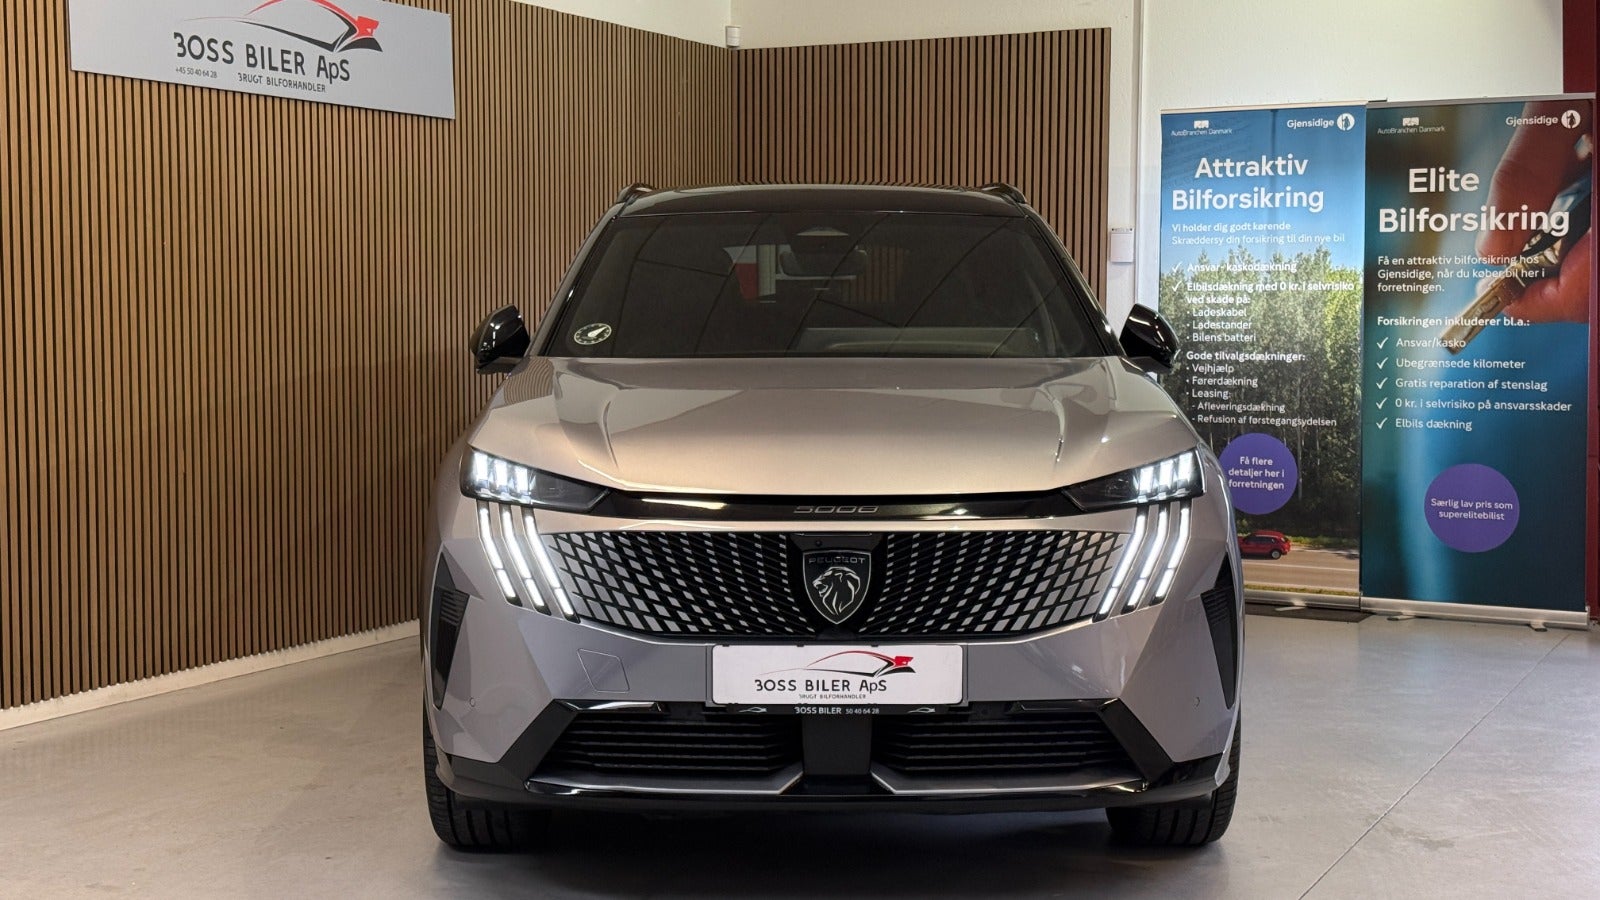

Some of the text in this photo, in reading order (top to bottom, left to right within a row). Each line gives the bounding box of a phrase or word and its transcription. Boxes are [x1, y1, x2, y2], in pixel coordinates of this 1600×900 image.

[245, 43, 306, 76] BILER
[316, 54, 350, 85] ApS
[266, 76, 326, 93] BILFORHANDLER
[1287, 118, 1335, 129] Gjensidige
[1505, 115, 1559, 127] Gjensidige
[1208, 128, 1233, 136] Danmark
[1418, 126, 1446, 134] Danmark
[1194, 153, 1309, 179] Attraktiv
[1408, 166, 1480, 193] Elite
[1172, 186, 1324, 213] Bilforsikring
[1379, 204, 1570, 237] Bilforsikring
[1172, 222, 1291, 234] Vi holder dig godt kørende
[1172, 233, 1345, 247] Skræddersy din forsikring til din nye bil
[1378, 255, 1540, 267] Få en attraktiv bilforsikring hos
[1377, 269, 1435, 280] Gjensidige,
[1437, 268, 1454, 279] når
[1456, 268, 1470, 278] du
[1521, 268, 1539, 278] her
[1541, 268, 1545, 278] i
[1256, 282, 1278, 291] med
[1279, 282, 1287, 291] 0
[1288, 282, 1301, 291] kr.
[1307, 283, 1355, 292] selvrisiko
[1377, 282, 1445, 294] forretningen.
[1187, 295, 1206, 305] ved
[1206, 295, 1234, 305] skade
[1192, 308, 1247, 318] Ladeskabel
[1192, 321, 1253, 330] Ladestander
[1377, 316, 1443, 328] Forsikringen
[1445, 317, 1501, 327] inkluderer
[1192, 333, 1257, 342] Bilens batteri
[1396, 337, 1467, 349] Ansvar/kasko
[1186, 351, 1306, 364] Gode tilvalgsdækninger:
[1192, 364, 1235, 375] Vejhjælp
[1396, 358, 1526, 370] Ubegrænsede kilometer
[1192, 377, 1259, 388] Førerdækning
[1395, 378, 1549, 393] Gratis reparation af stenslag
[1197, 402, 1286, 414] Afleveringsdækning
[1395, 399, 1403, 408] 0
[1405, 399, 1418, 409] kr.
[1425, 399, 1476, 410] selvrisiko
[1477, 400, 1492, 413] på
[1494, 401, 1573, 412] ansvarsskader
[1197, 415, 1237, 425] Refusion
[1238, 415, 1247, 424] af
[1395, 419, 1473, 432] Elbils dækning
[1240, 456, 1274, 466] Få flere
[1228, 468, 1263, 479] detaljer
[1265, 469, 1280, 478] her
[1228, 479, 1285, 491] forretningen
[793, 505, 880, 514] 5008
[1431, 498, 1513, 510] Særlig lav pris som
[1439, 511, 1505, 521] superelitebilist
[808, 556, 867, 565] PEUGEOT
[805, 679, 851, 692] BILER
[859, 679, 887, 695] ApS
[818, 706, 842, 715] BILER
